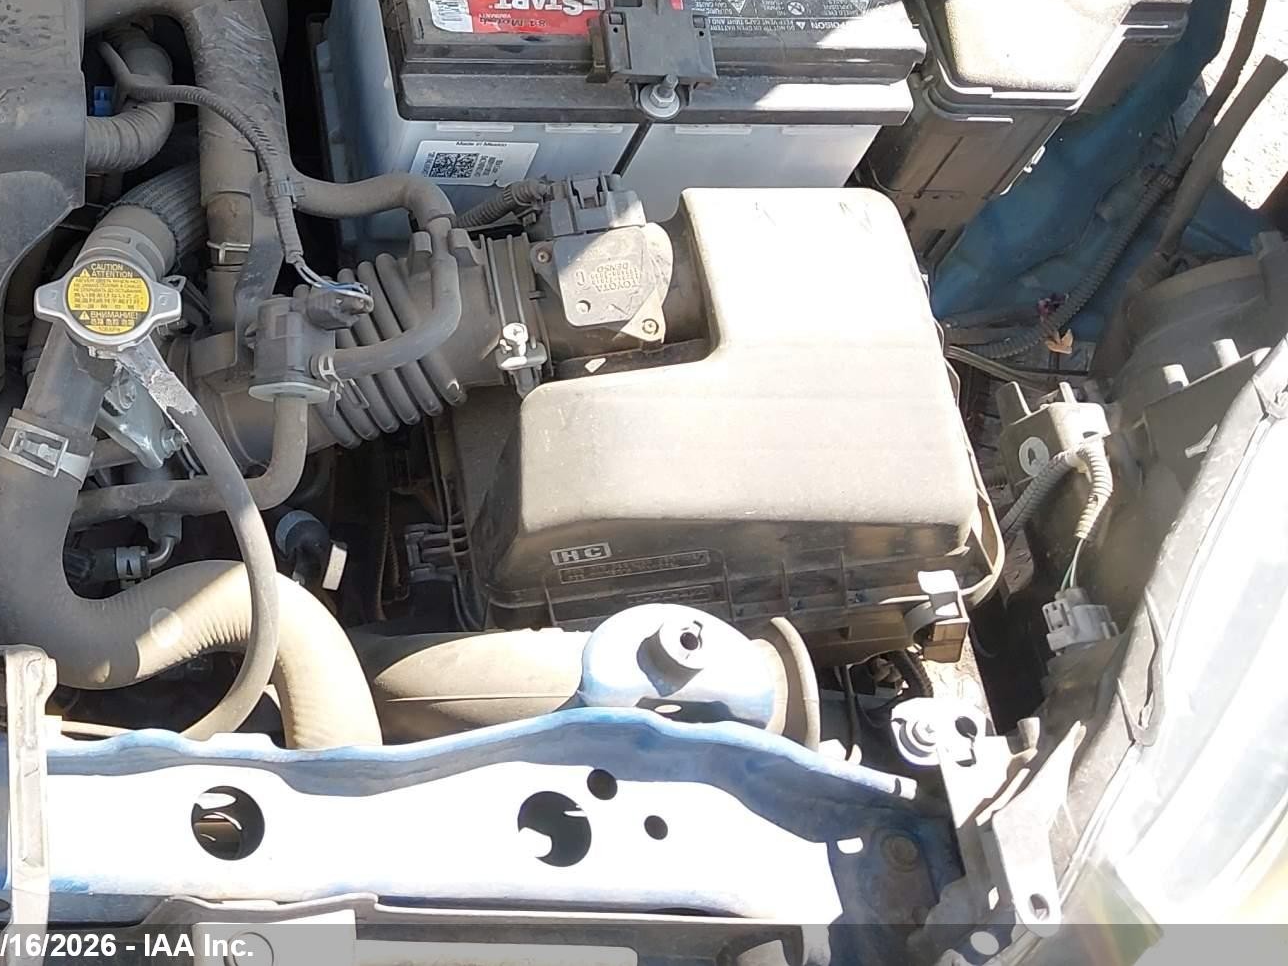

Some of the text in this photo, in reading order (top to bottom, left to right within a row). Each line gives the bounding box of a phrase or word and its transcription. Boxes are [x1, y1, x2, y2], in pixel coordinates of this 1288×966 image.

[91, 263, 124, 271] CAUTION
[596, 262, 629, 273] DENSO
[92, 270, 134, 278] ATTENTION
[594, 278, 640, 293] TOYOTA
[561, 546, 604, 563] HC
